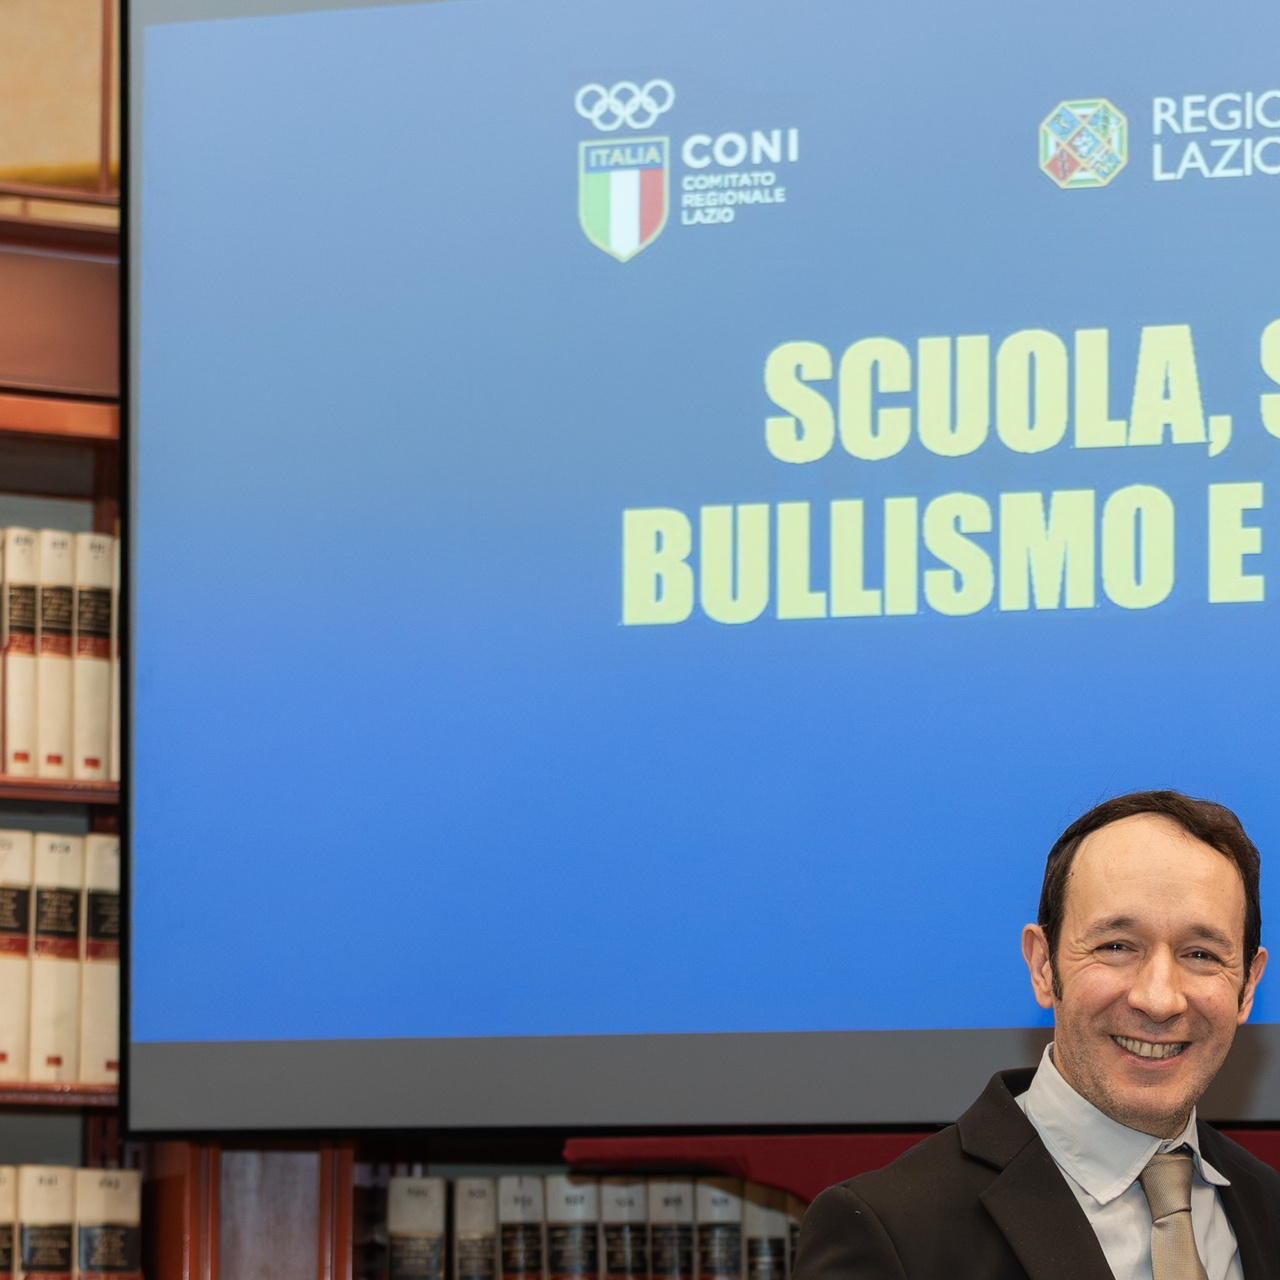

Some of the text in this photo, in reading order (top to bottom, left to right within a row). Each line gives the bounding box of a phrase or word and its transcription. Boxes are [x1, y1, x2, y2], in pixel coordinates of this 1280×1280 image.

[589, 146, 662, 168] ITALIA
[682, 128, 799, 169] CONI
[682, 171, 776, 191] COMITATO
[681, 186, 786, 208] REGIONALE
[681, 206, 735, 225] LAZIO
[764, 324, 1232, 464] SCUOLA,
[622, 484, 1175, 626] BULLISMO
[1208, 482, 1264, 603] E
